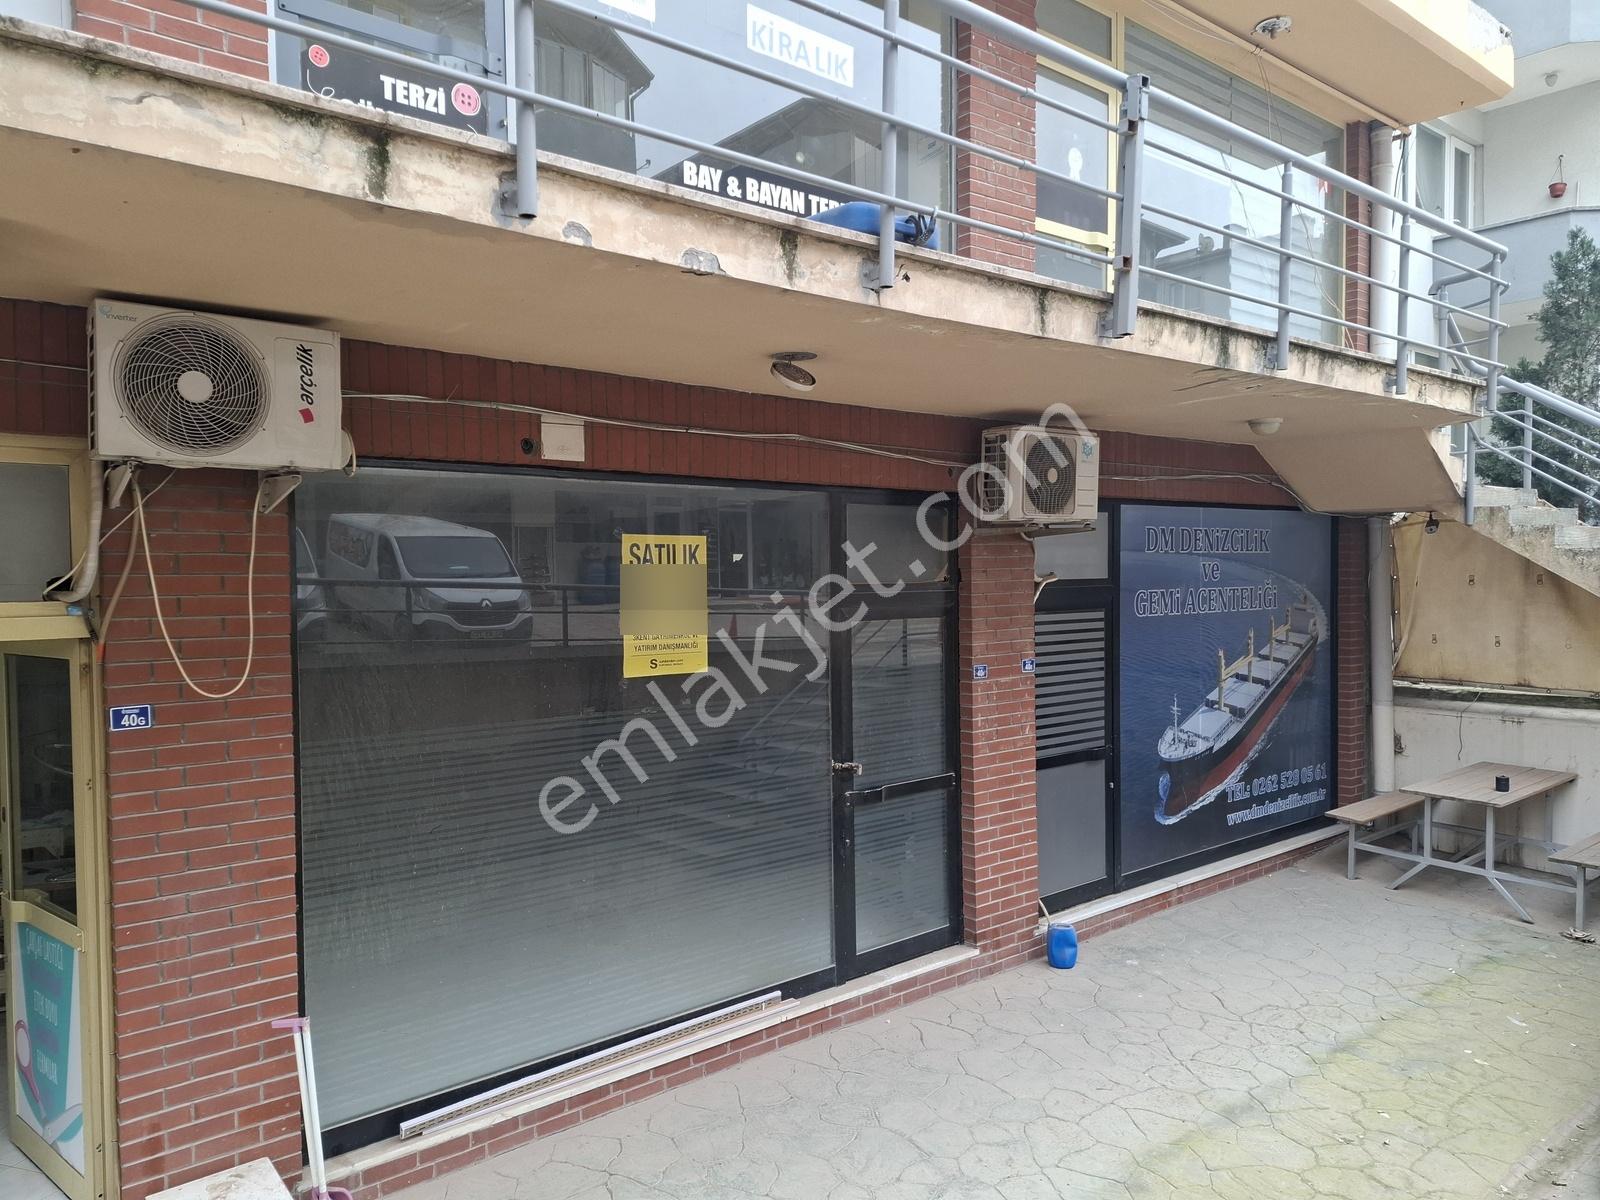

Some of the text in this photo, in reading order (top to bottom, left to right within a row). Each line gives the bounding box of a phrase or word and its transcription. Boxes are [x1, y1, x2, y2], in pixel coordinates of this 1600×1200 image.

[751, 18, 851, 82] KİRALIK
[379, 74, 446, 116] TERZİ
[682, 160, 724, 193] BAY
[727, 175, 742, 199] &
[746, 177, 805, 215] BAYAN
[296, 343, 315, 406] arçelik
[1144, 526, 1175, 553] DM
[1200, 559, 1220, 582] ve
[633, 640, 699, 653] YATIRIM DANIŞMANLIĞI
[650, 659, 658, 669] S
[121, 714, 146, 727] 40G
[1226, 781, 1251, 803] TEL:
[1226, 788, 1327, 826] www.dmdenizcilik.com.tr
